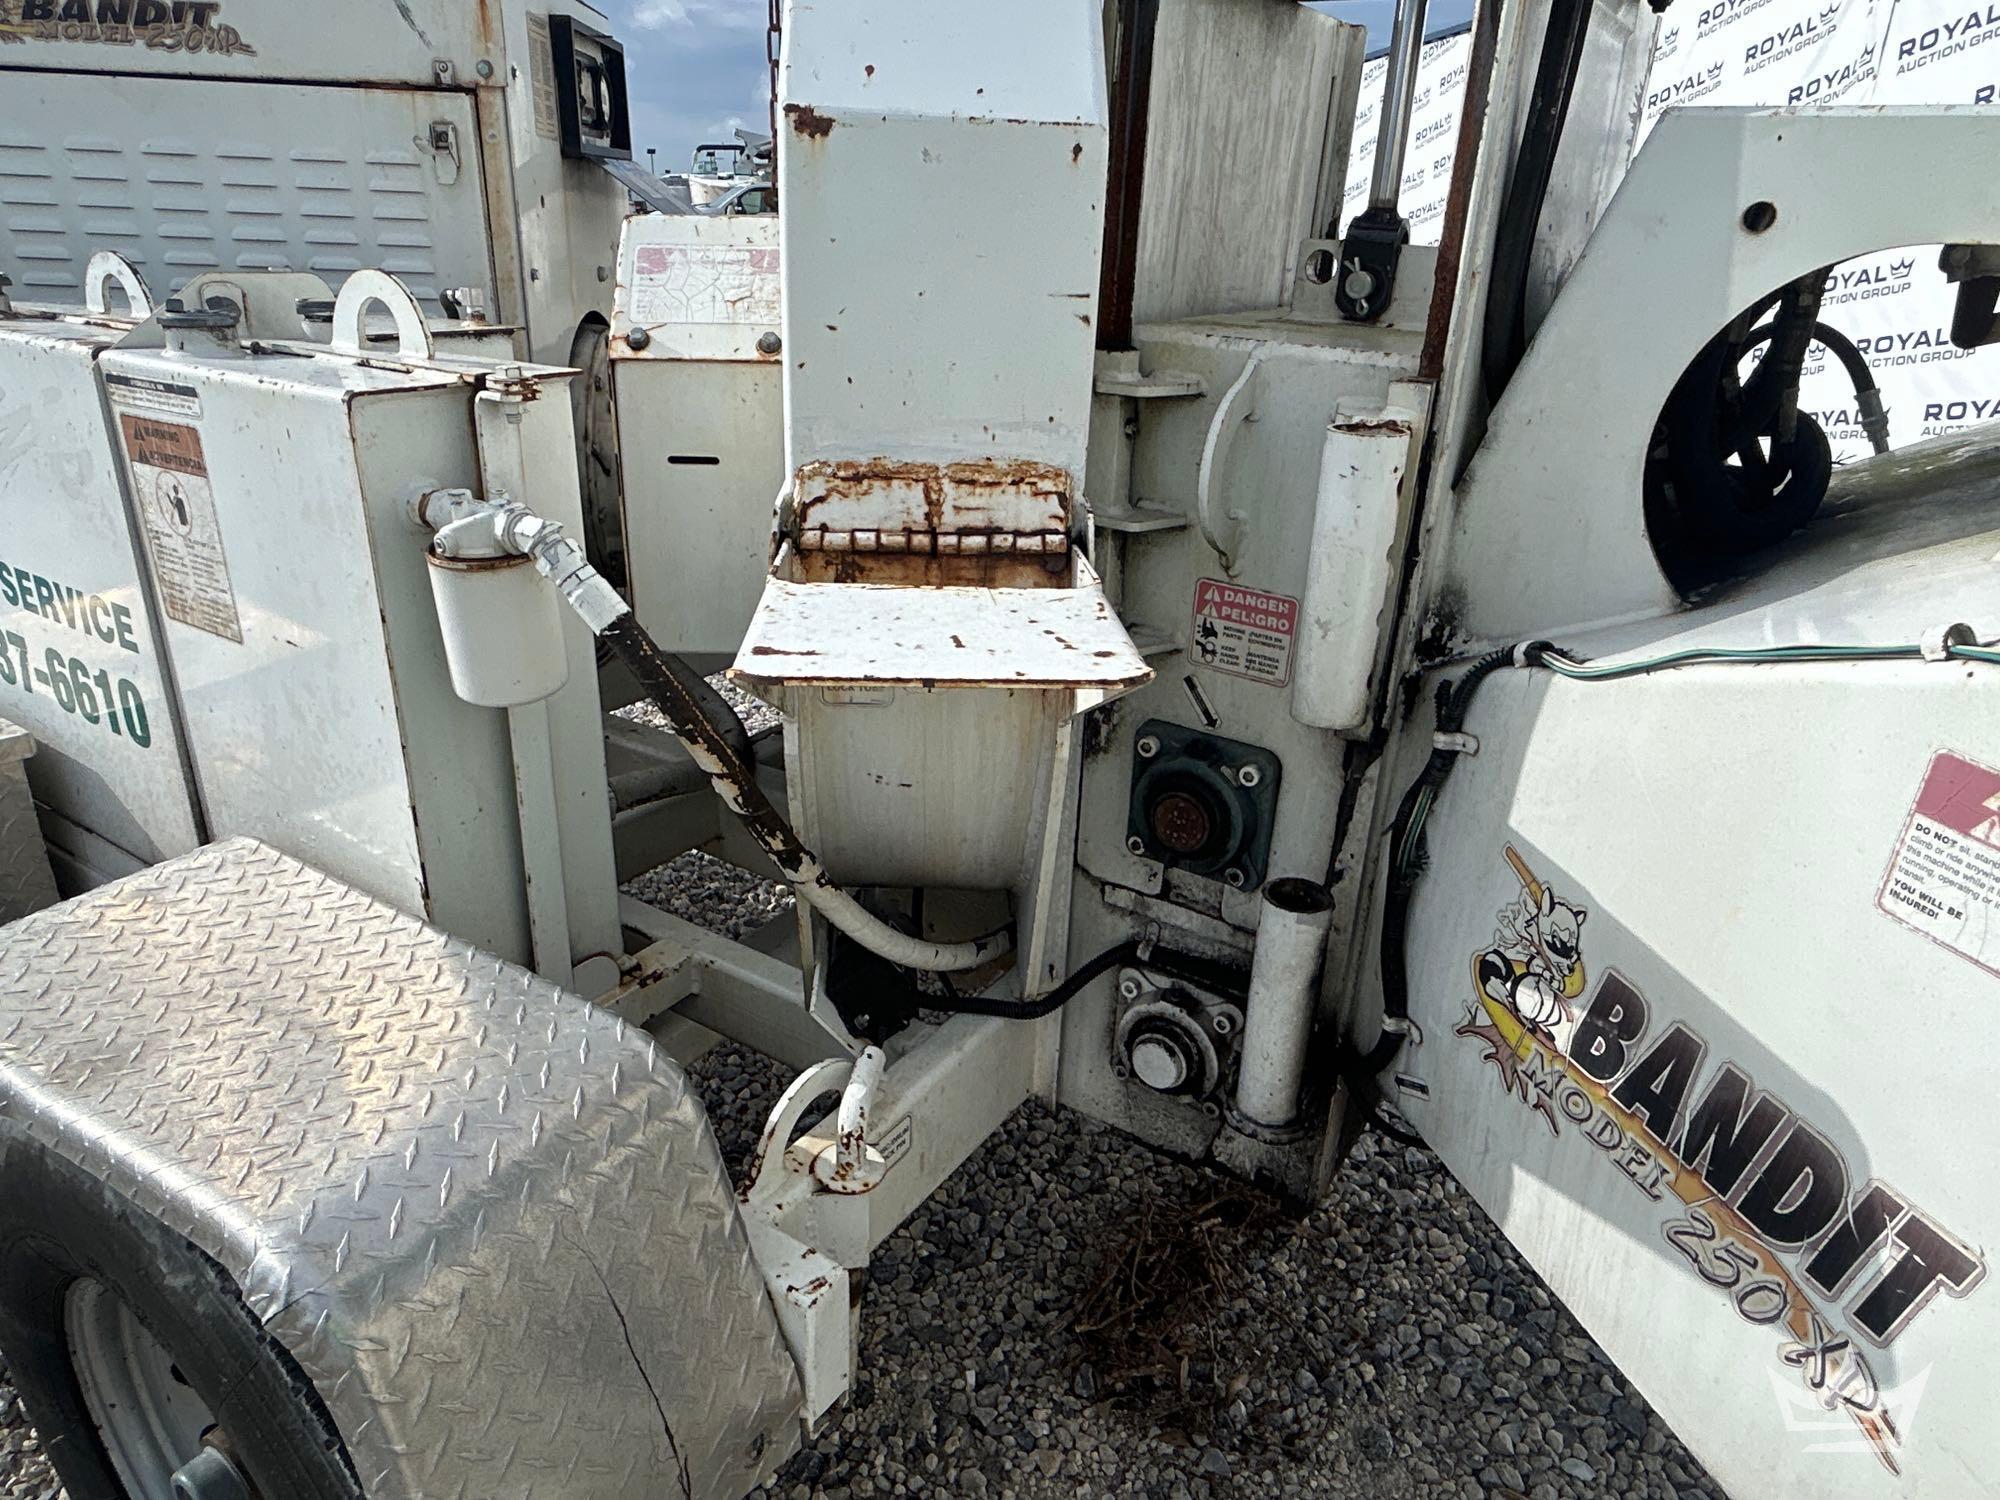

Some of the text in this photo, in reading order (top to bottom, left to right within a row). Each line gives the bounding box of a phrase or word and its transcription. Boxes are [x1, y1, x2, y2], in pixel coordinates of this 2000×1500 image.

[21, 0, 221, 27] BANDIT
[1697, 11, 1741, 40] AUCTION
[34, 21, 135, 45] MODEL
[1745, 17, 1818, 63] ROYAL
[1653, 45, 1677, 62] ROUP
[1744, 24, 1837, 76] AUCTION GROUP
[1897, 40, 1966, 76] AUCTION
[1440, 64, 1465, 88] ROYA
[1647, 72, 1706, 109] ROYAL
[1688, 80, 1722, 102] GROUP
[1433, 153, 1452, 172] ROY
[1822, 266, 1888, 293] OYAL
[1819, 282, 1912, 308] CTION GROUP
[1856, 328, 1949, 356] ROYAL
[1920, 347, 1976, 364] GROUP
[1923, 399, 2000, 421] ROYA
[1839, 430, 1868, 440] GRO
[0, 561, 140, 654] SERVICE
[1223, 590, 1290, 615] DANGER
[1221, 605, 1290, 631] PELIGRO
[1915, 822, 1931, 835] DO
[1934, 831, 1958, 848] NOT
[1906, 844, 1922, 858] this
[1923, 853, 1961, 877] machine
[1962, 872, 1987, 890] while
[1910, 835, 2000, 883] climb or ride anywhe
[1893, 877, 1964, 921] YOU WILL BE
[1938, 873, 1981, 901] operating
[1982, 895, 1993, 905] or
[1889, 887, 1940, 920] INJURED!
[1521, 1052, 1678, 1201] MODEL
[1566, 968, 1986, 1348] BANDIT
